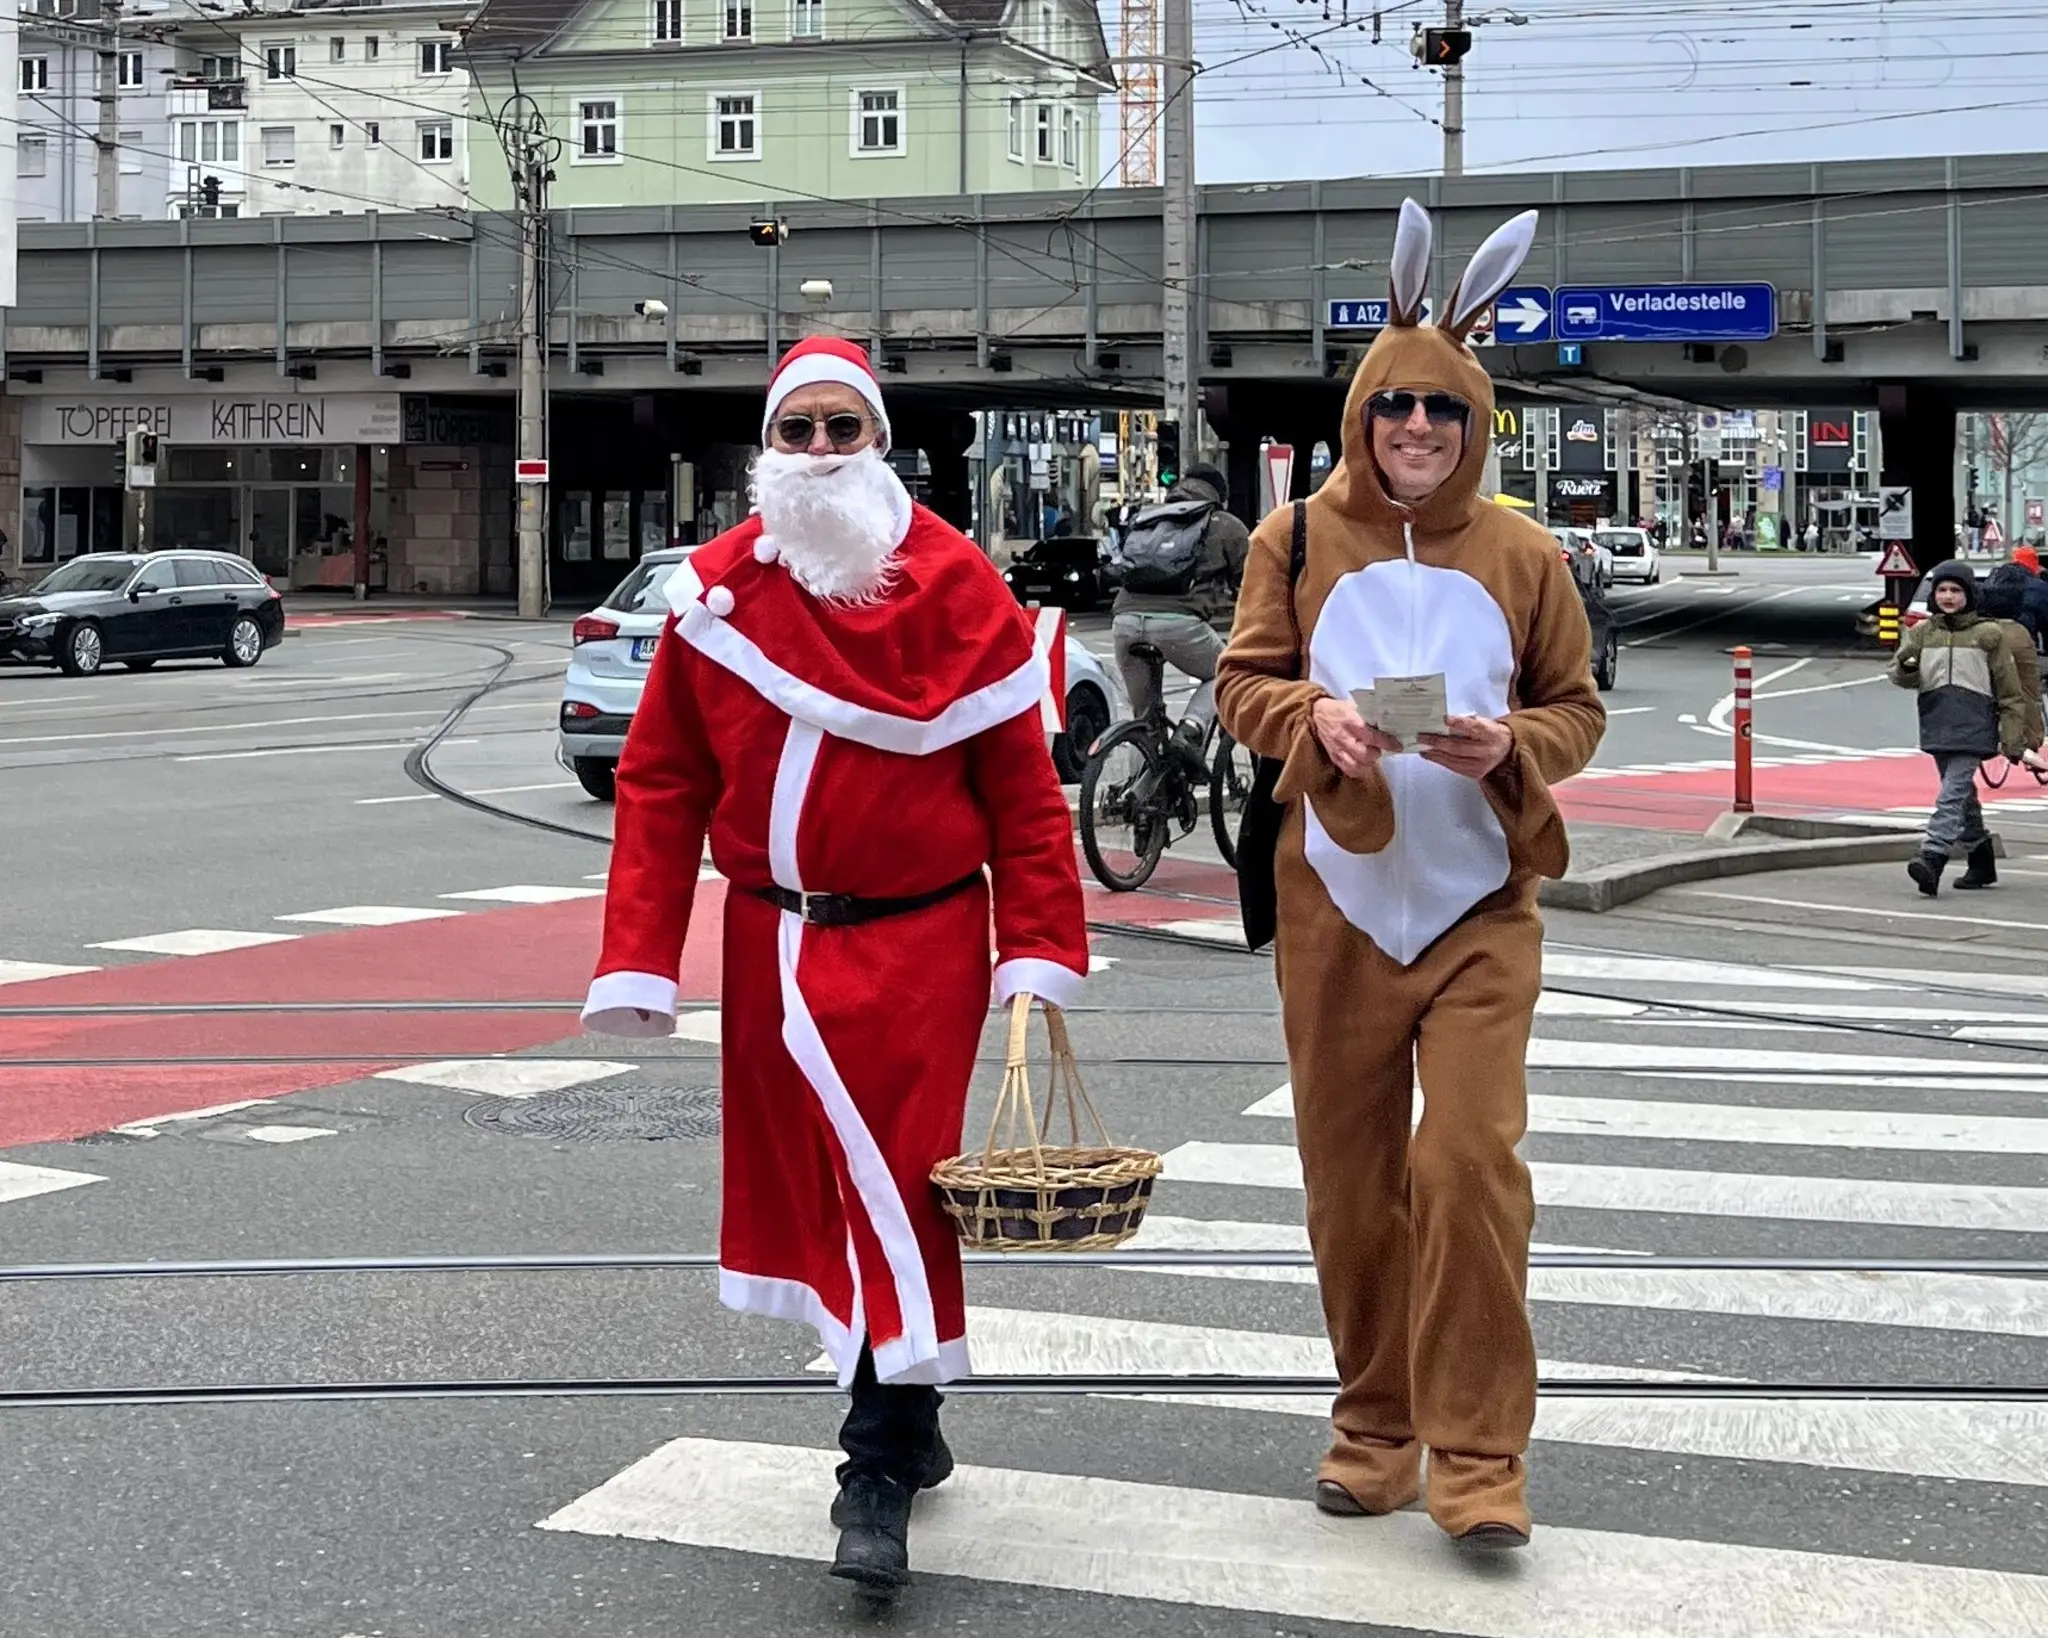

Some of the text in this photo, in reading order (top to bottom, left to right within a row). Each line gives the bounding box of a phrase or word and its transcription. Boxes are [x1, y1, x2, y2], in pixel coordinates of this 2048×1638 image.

[1609, 292, 1747, 312] Verladestelle
[1356, 304, 1381, 323] A12
[55, 398, 325, 439] TÖPFEREI KATHREIN
[1556, 480, 1602, 496] Ruetz
